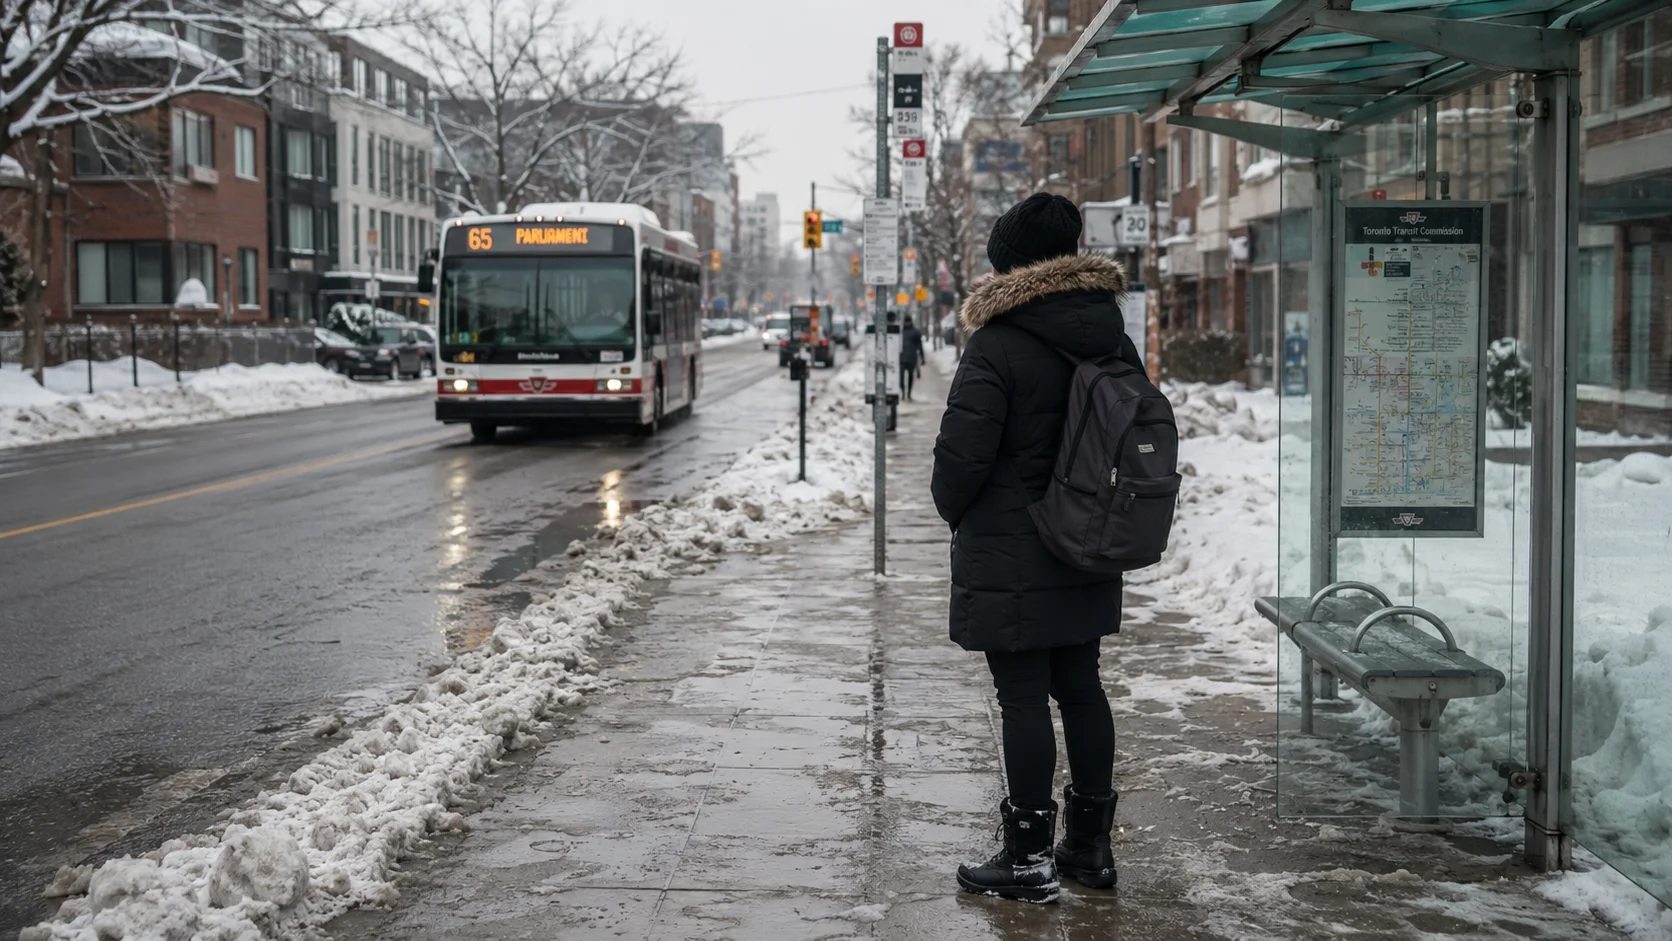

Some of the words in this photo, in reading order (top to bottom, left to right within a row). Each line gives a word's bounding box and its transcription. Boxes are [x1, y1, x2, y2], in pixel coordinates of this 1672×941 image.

[1127, 217, 1146, 232] 20
[1363, 226, 1391, 236] Toronto
[1393, 226, 1418, 236] Transit
[1420, 226, 1463, 236] Commission
[468, 227, 493, 251] 65
